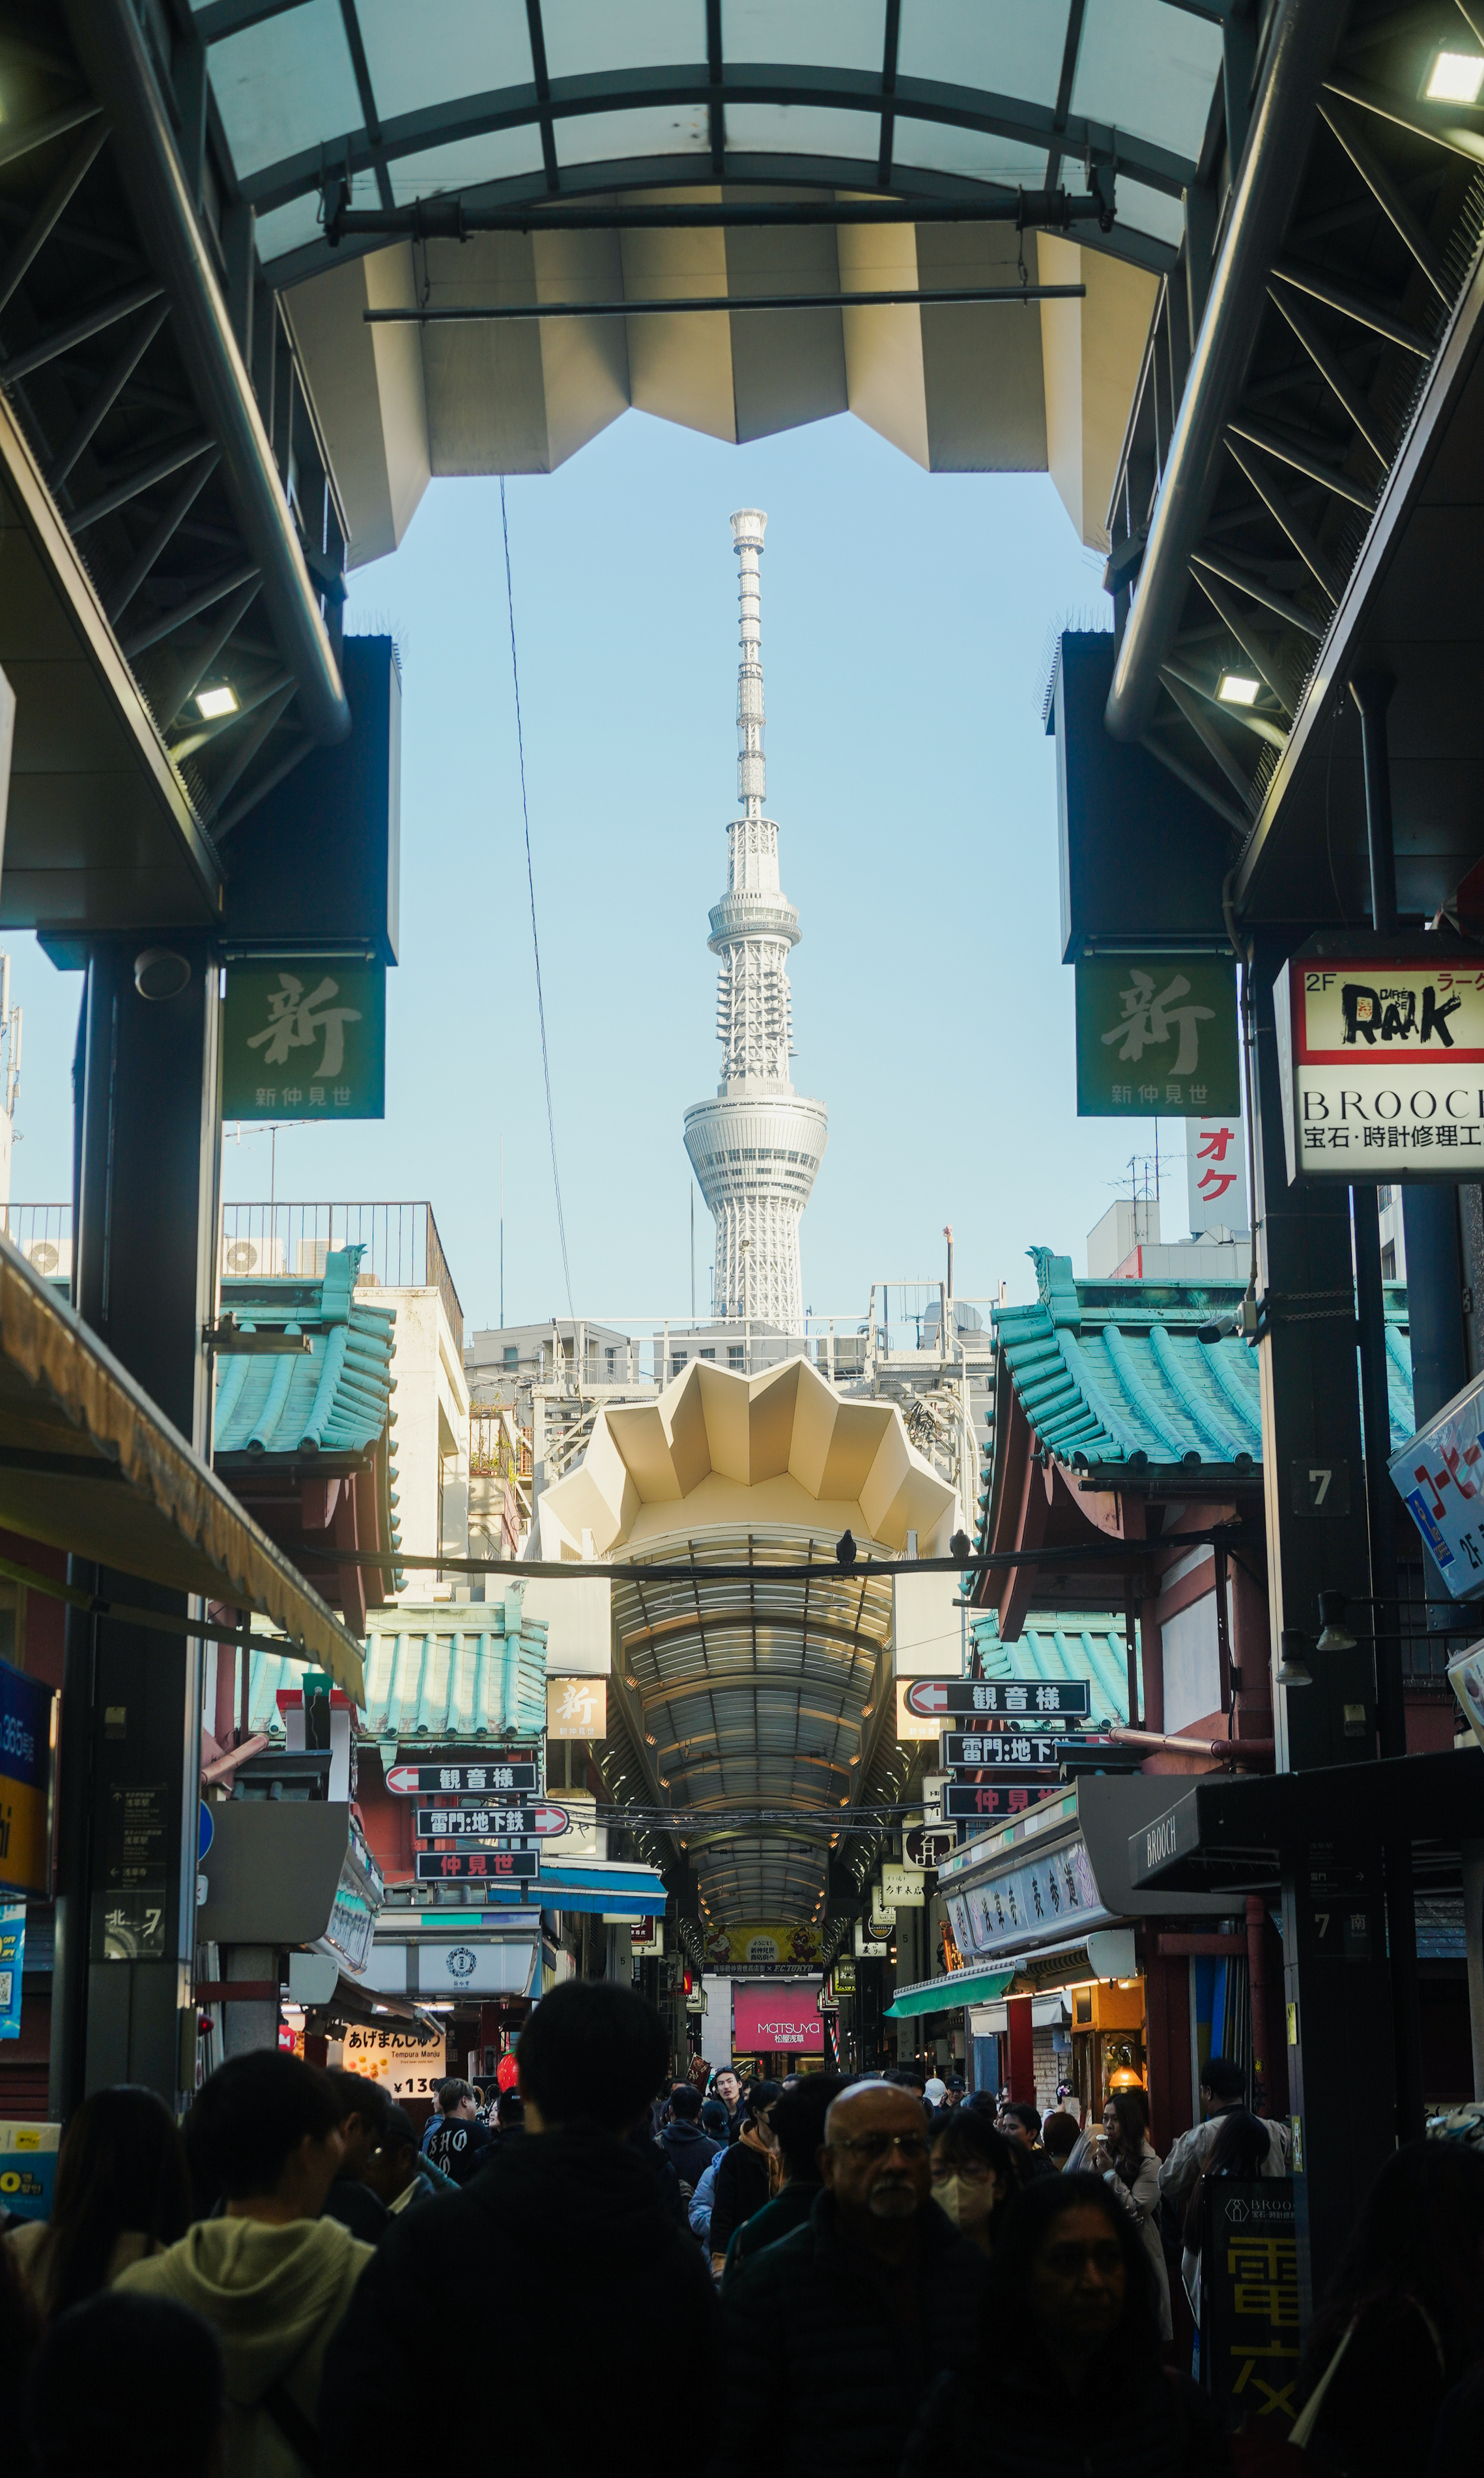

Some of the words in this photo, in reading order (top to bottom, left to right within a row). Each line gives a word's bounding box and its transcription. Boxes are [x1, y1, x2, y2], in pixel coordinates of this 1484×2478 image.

[1306, 973, 1337, 991] 2F
[247, 973, 362, 1078] 新
[1101, 969, 1216, 1076] 新
[255, 1086, 352, 1107] 新仲見世
[1111, 1084, 1209, 1105] 新仲見世
[1304, 1125, 1484, 1149] 宝石・時計修理工
[1197, 1116, 1237, 1202] オケ
[1308, 1470, 1332, 1506] 7
[556, 1684, 598, 1725] 新
[973, 1686, 1061, 1710] 観音様
[559, 1727, 595, 1736] 新仲見世
[962, 1737, 1072, 1763] 雷門:地下
[439, 1768, 513, 1789] 観音様
[1147, 1815, 1177, 1868] BROOCH
[440, 1854, 514, 1876] 仲見世
[145, 1908, 162, 1934] 7
[1314, 1913, 1330, 1938] 7
[1350, 1913, 1366, 1930] 南
[902, 1934, 908, 1942] 5
[620, 1957, 625, 1965] 5
[774, 2034, 805, 2043] 松屋浅草
[1251, 2199, 1295, 2210] BROO
